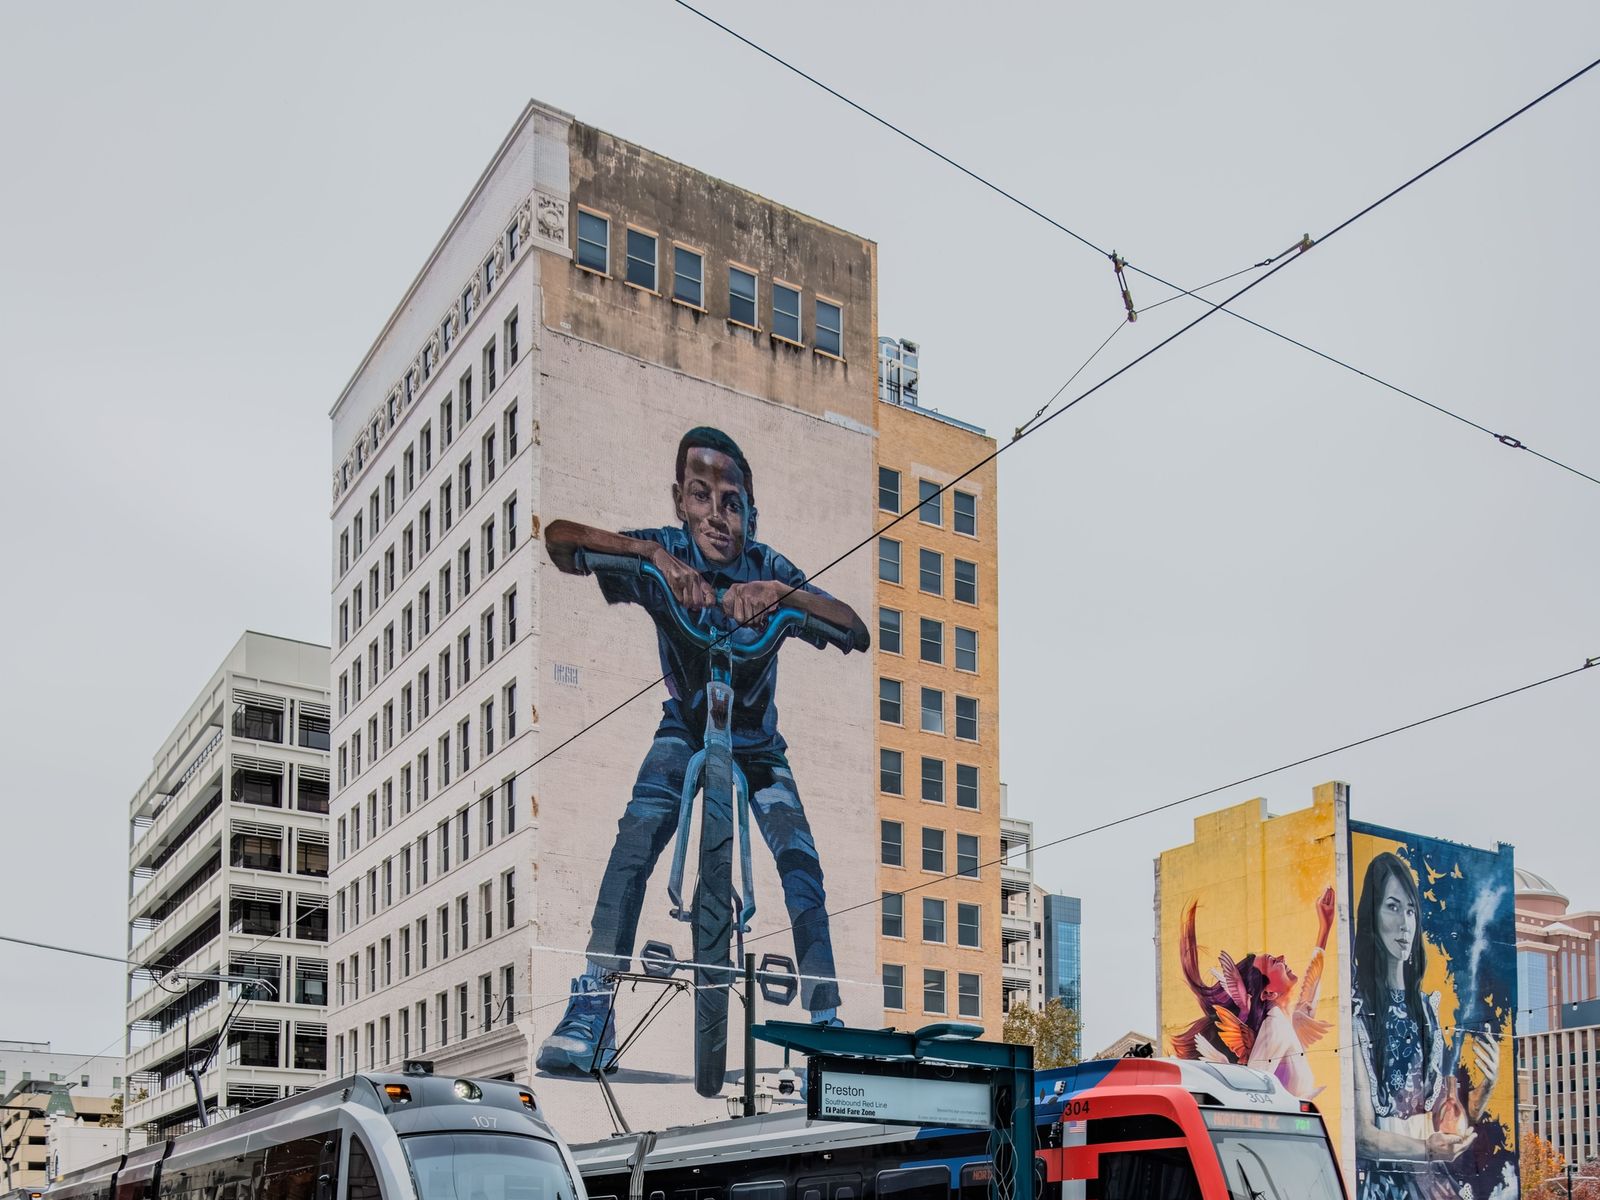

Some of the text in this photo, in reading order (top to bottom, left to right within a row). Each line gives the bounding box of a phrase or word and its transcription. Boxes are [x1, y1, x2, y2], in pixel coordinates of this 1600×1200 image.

[825, 1083, 865, 1097] Preston
[825, 1098, 861, 1108] Southbound
[862, 1100, 874, 1108] Red
[1247, 1092, 1273, 1105] 304
[832, 1107, 876, 1117] Paid Fare Zone
[1065, 1100, 1090, 1116] 304
[472, 1115, 498, 1129] 107
